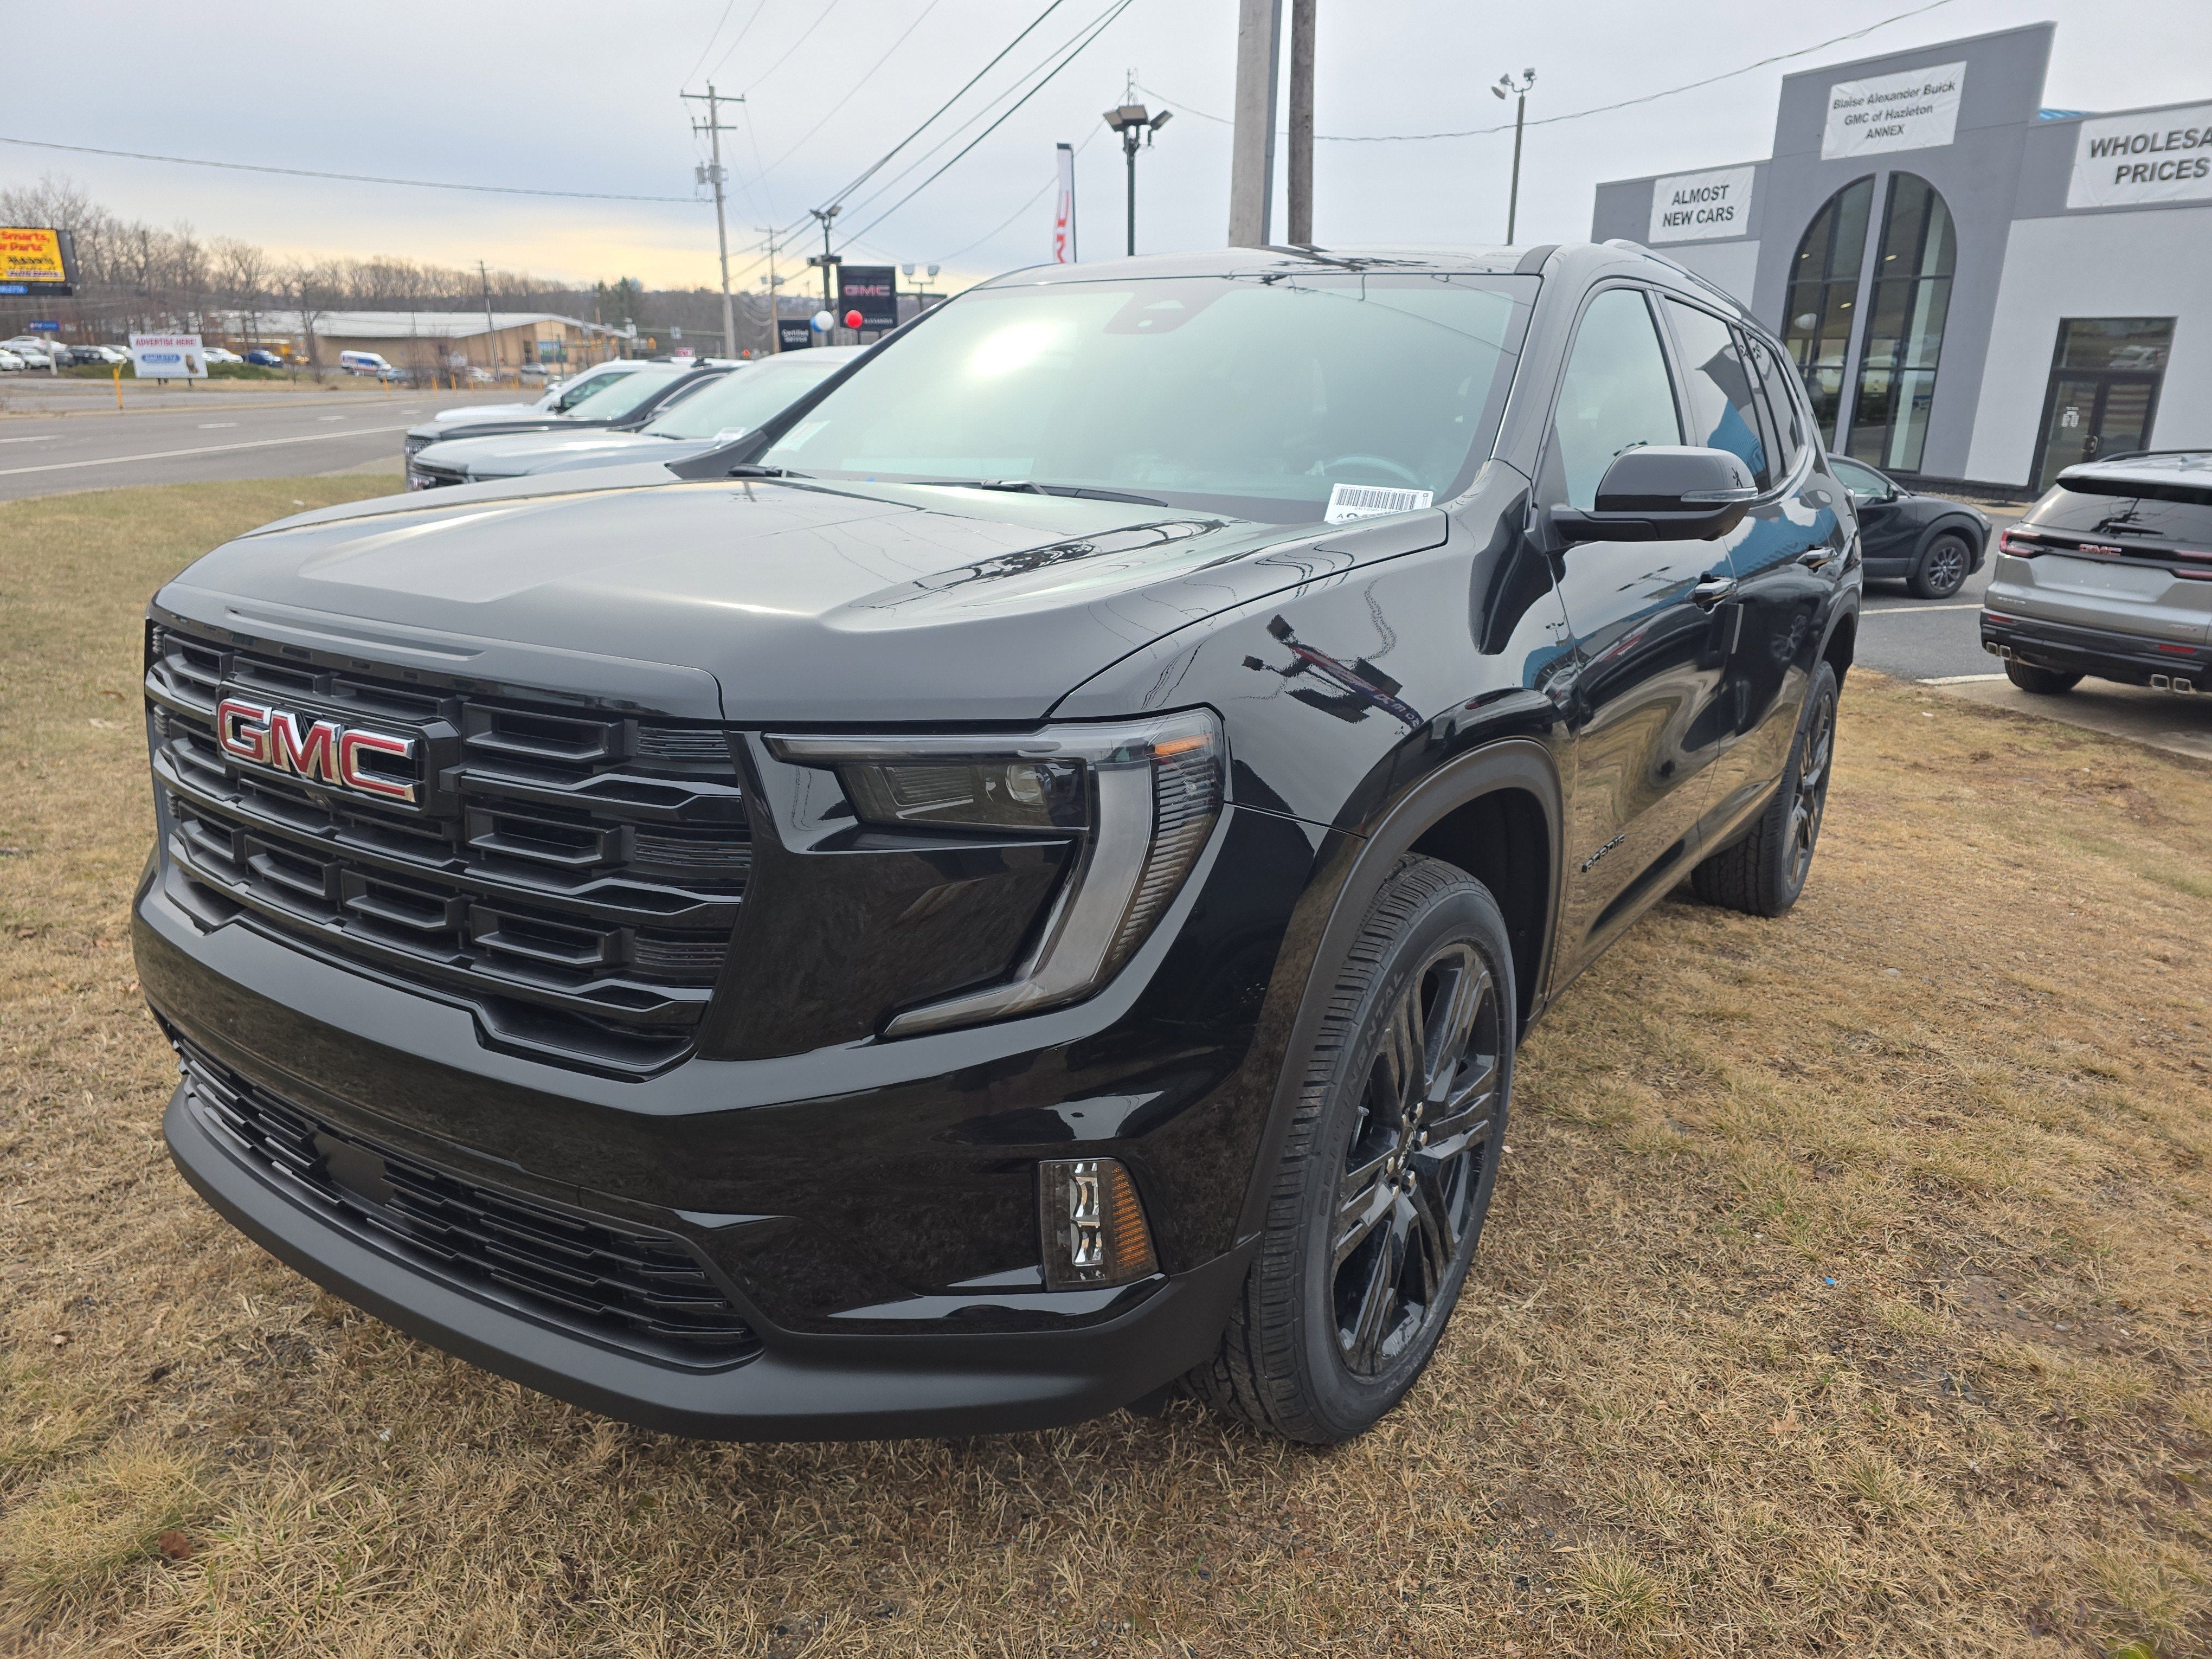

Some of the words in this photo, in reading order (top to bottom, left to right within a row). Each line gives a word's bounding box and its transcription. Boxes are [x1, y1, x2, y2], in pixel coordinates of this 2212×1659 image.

[1833, 97, 1864, 110] Blaise
[1867, 87, 1921, 105] Alexander
[1923, 80, 1956, 95] Buick
[1844, 112, 1869, 126] GMC
[1872, 110, 1883, 122] of
[1885, 104, 1934, 121] Hazleton
[1866, 124, 1905, 139] ANNEX
[2115, 157, 2212, 184] PRICES
[1671, 184, 1730, 205] ALMOST
[1663, 210, 1694, 227] NEW
[1697, 205, 1734, 224] CARS
[844, 285, 891, 297] GMC
[136, 338, 173, 346] ADVERTISE
[2078, 543, 2122, 557] GMC
[217, 698, 415, 803] GMC
